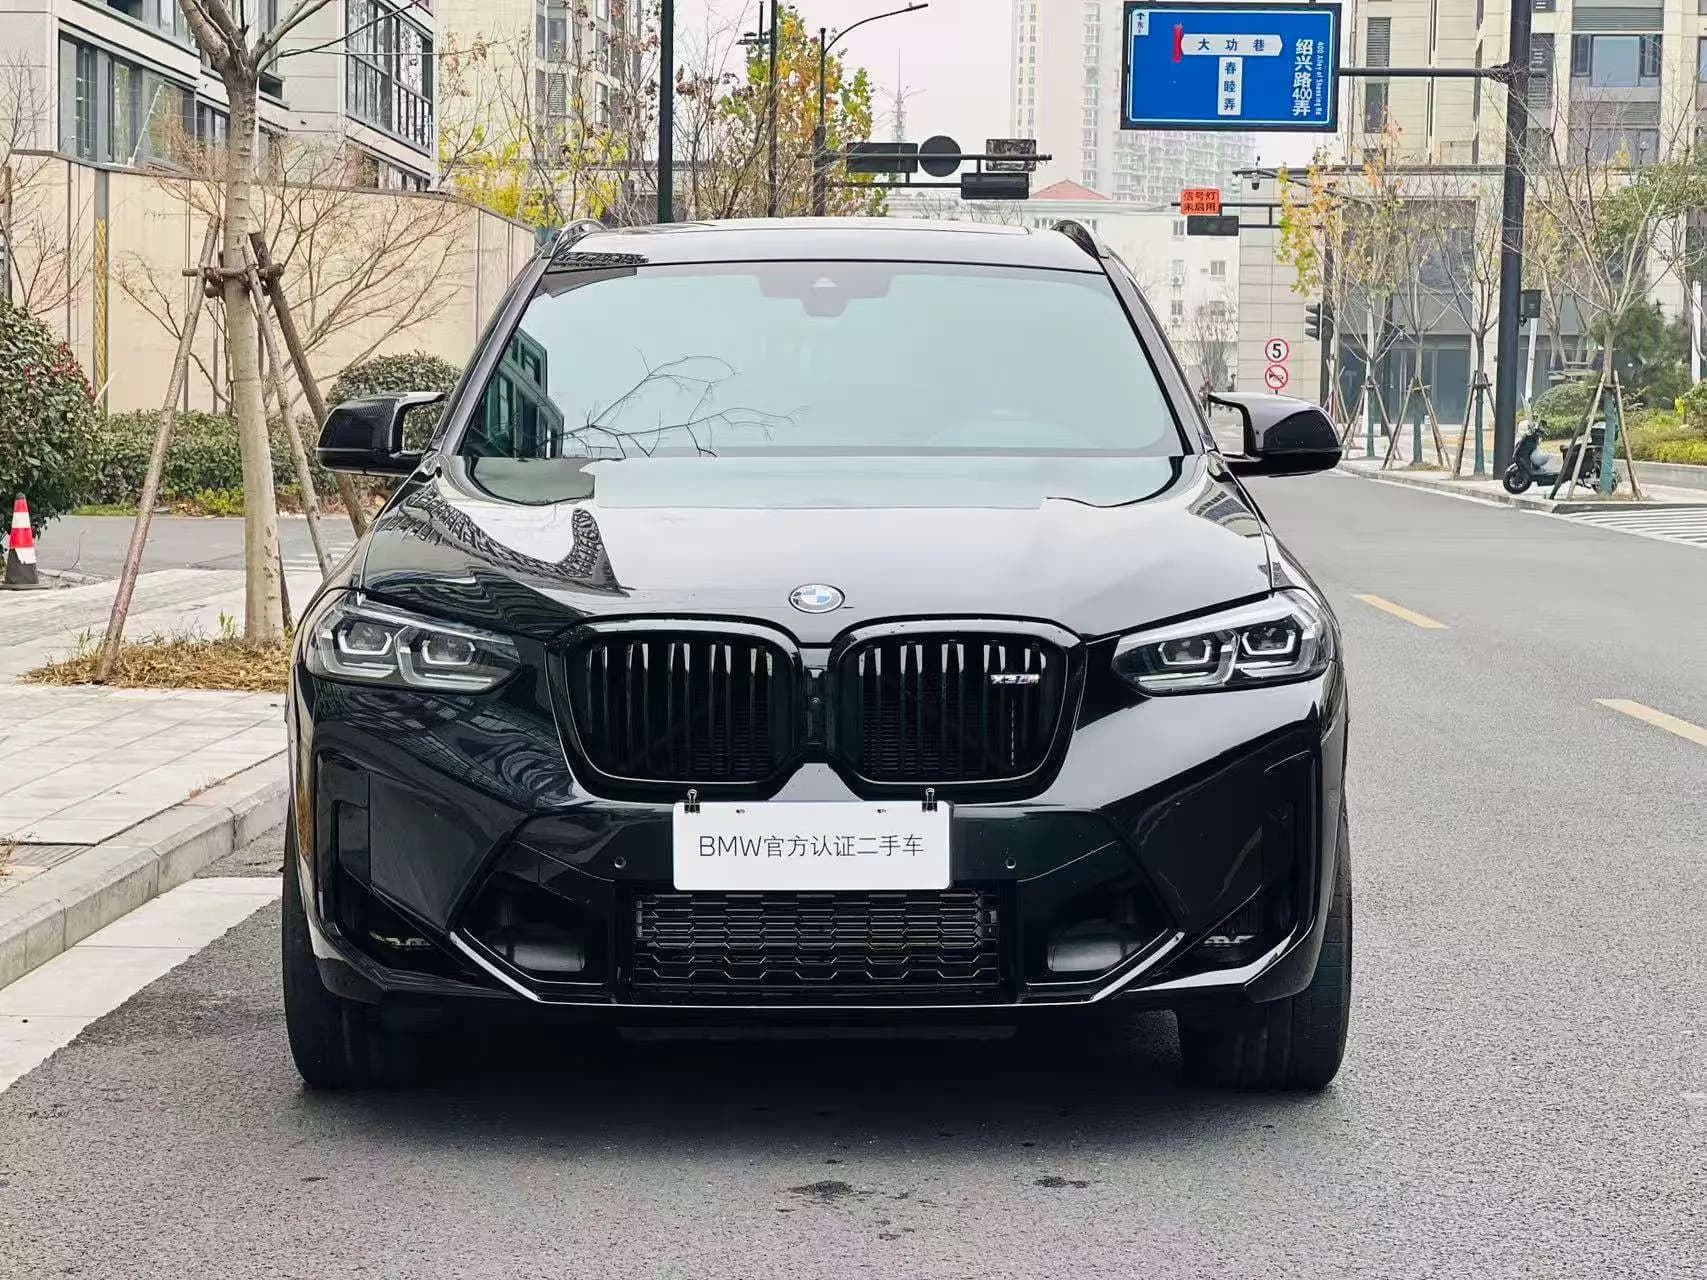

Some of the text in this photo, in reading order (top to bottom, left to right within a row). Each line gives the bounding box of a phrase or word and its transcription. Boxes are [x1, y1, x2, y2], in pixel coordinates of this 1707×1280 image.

[1198, 38, 1265, 52] 大功巷
[1292, 38, 1313, 116] 绍兴路400弄
[1223, 61, 1237, 111] 春睦弄
[1184, 191, 1216, 201] 信号灯
[1184, 202, 1216, 212] 未启用
[1272, 343, 1281, 359] 5
[699, 834, 924, 858] BMW官方认证二手车
